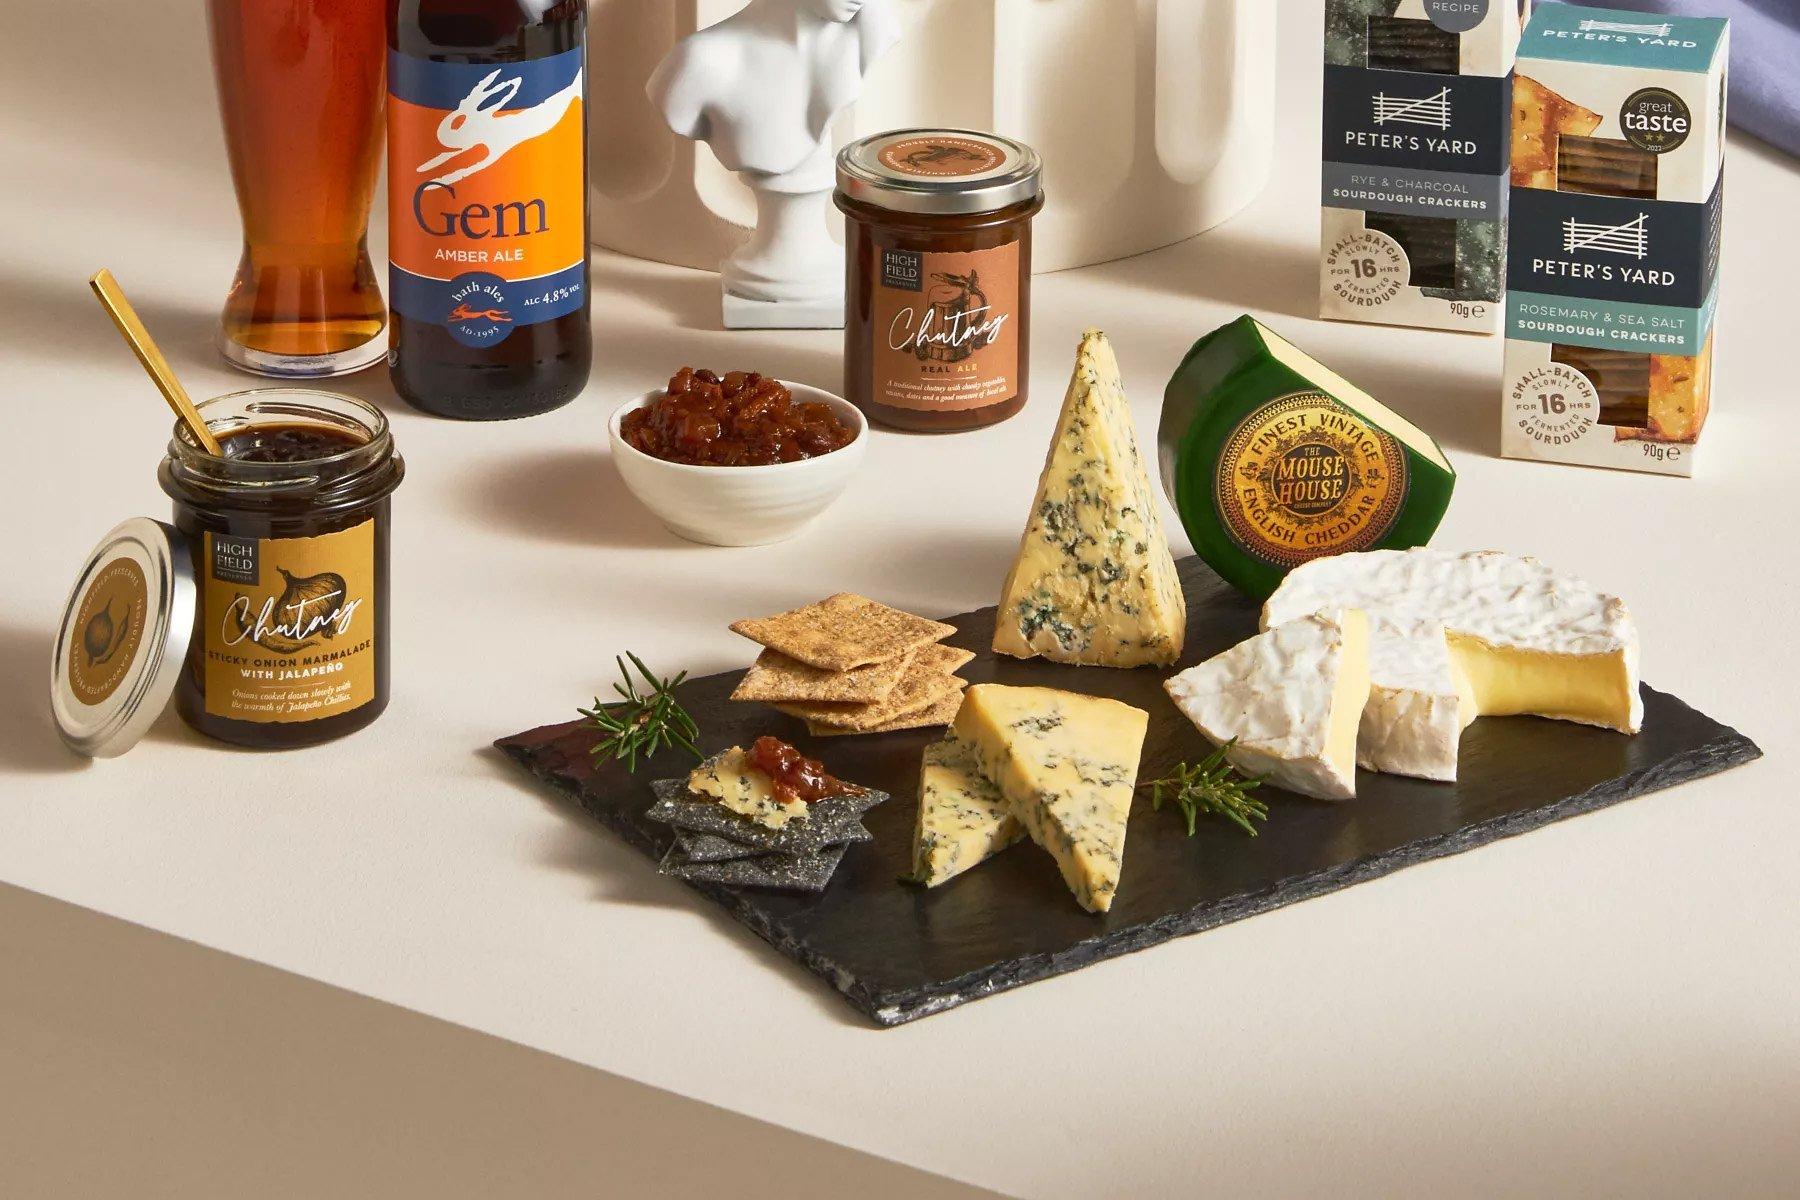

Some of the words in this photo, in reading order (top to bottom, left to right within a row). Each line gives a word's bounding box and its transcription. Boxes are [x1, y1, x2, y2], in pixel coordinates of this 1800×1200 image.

[1432, 2, 1479, 13] RECIPE
[1543, 29, 1628, 43] PETER'S
[1637, 36, 1697, 48] YARD
[1639, 102, 1672, 115] great
[1624, 111, 1687, 133] taste
[1346, 131, 1419, 150] PETER'S
[1426, 138, 1477, 155] YARD
[1351, 175, 1376, 185] RYE
[1381, 177, 1389, 187] &
[1395, 179, 1469, 194] CHARCOAL
[1333, 188, 1413, 204] SOURDOUGH
[1418, 196, 1487, 210] CRACKERS
[413, 181, 549, 239] Gem
[435, 249, 488, 262] AMBER
[493, 249, 524, 262] ALE
[886, 253, 917, 267] HIGH
[1345, 245, 1380, 257] SLOWLY
[886, 264, 917, 278] FIELD
[1350, 258, 1377, 279] 16
[1533, 258, 1613, 281] PETER'S
[1620, 267, 1676, 287] YARD
[452, 281, 480, 302] bath
[483, 284, 505, 303] ales
[1333, 280, 1402, 307] SOURDOUGH
[1344, 277, 1390, 295] FERMENTED
[524, 297, 540, 306] ALC
[542, 287, 569, 304] 4.8%
[1450, 302, 1469, 319] 90g
[1519, 303, 1597, 321] ROSEMARY
[1603, 313, 1612, 323] &
[1618, 314, 1645, 325] SEA
[1651, 317, 1685, 329] SALT
[888, 305, 1009, 350] Chutney
[1518, 319, 1605, 338] SOURDOUGH
[1610, 329, 1685, 345] CRACKERS
[920, 365, 951, 373] REAL
[957, 363, 978, 373] ALE
[923, 380, 946, 394] chutney
[1532, 379, 1570, 391] SLOWLY
[940, 393, 955, 403] good
[1537, 393, 1566, 415] 16
[1518, 417, 1592, 445] SOURDOUGH
[1530, 413, 1580, 433] FERMENTED
[1251, 413, 1308, 456] FINEST
[1319, 413, 1378, 463] VINTAGE
[1304, 447, 1320, 456] THE
[1643, 443, 1664, 461] 90g
[1277, 456, 1345, 480] MOUSE
[1279, 479, 1343, 504] HOUSE
[1243, 488, 1296, 543] ENGLISH
[1304, 495, 1375, 546] CHEDDAR
[217, 541, 252, 557] HIGH
[217, 555, 253, 570] FIELD
[222, 589, 363, 646] Chutney
[208, 650, 248, 665] STICKY
[253, 658, 298, 667] ONION
[302, 639, 371, 665] MARMALADE
[241, 668, 274, 679] WITH
[278, 662, 344, 681] JALAPEÑO
[232, 689, 258, 699] Onions
[260, 691, 287, 700] cooked
[287, 690, 309, 699] down
[310, 686, 334, 697] slowly
[336, 680, 351, 692] with
[231, 700, 242, 709] the
[244, 703, 274, 711] warmth
[276, 702, 284, 712] of
